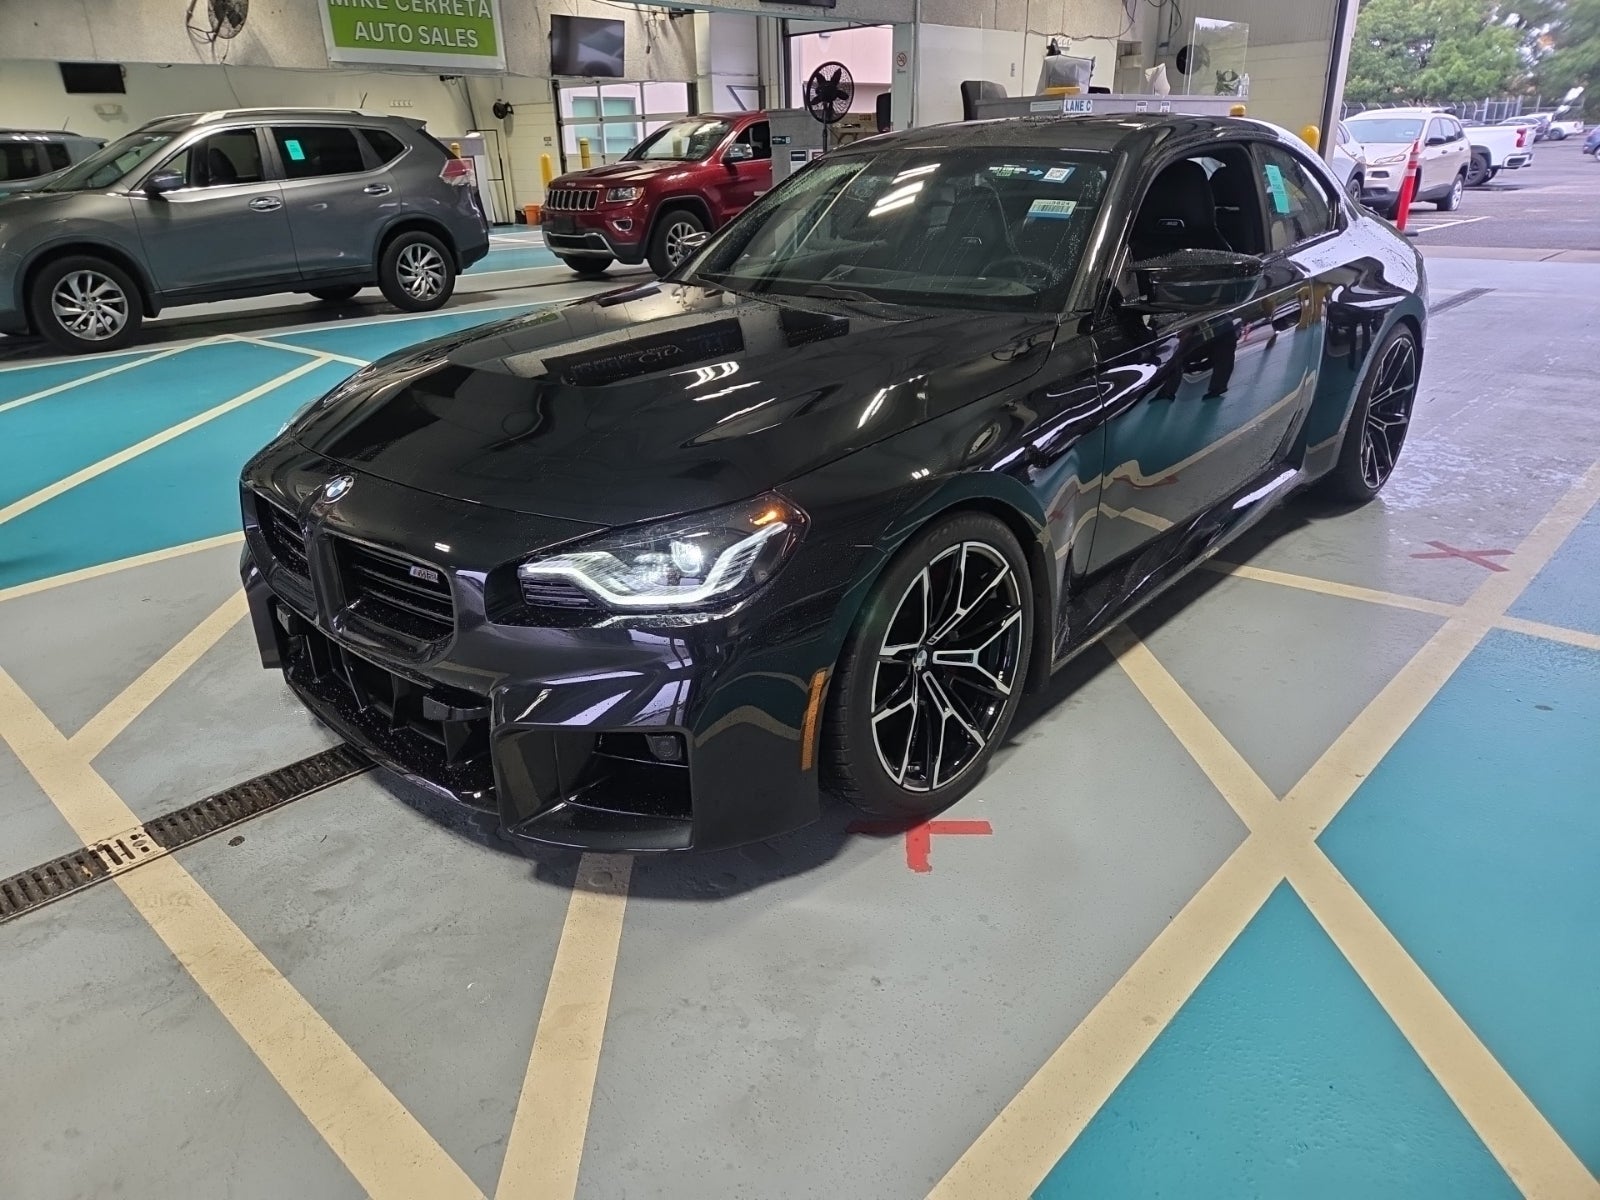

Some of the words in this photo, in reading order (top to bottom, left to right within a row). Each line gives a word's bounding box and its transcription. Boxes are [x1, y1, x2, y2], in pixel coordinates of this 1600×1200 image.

[395, 0, 491, 18] CERRETA
[355, 21, 413, 43] AUTO
[418, 25, 479, 48] SALES
[1065, 100, 1085, 111] LANE
[1086, 100, 1092, 111] C
